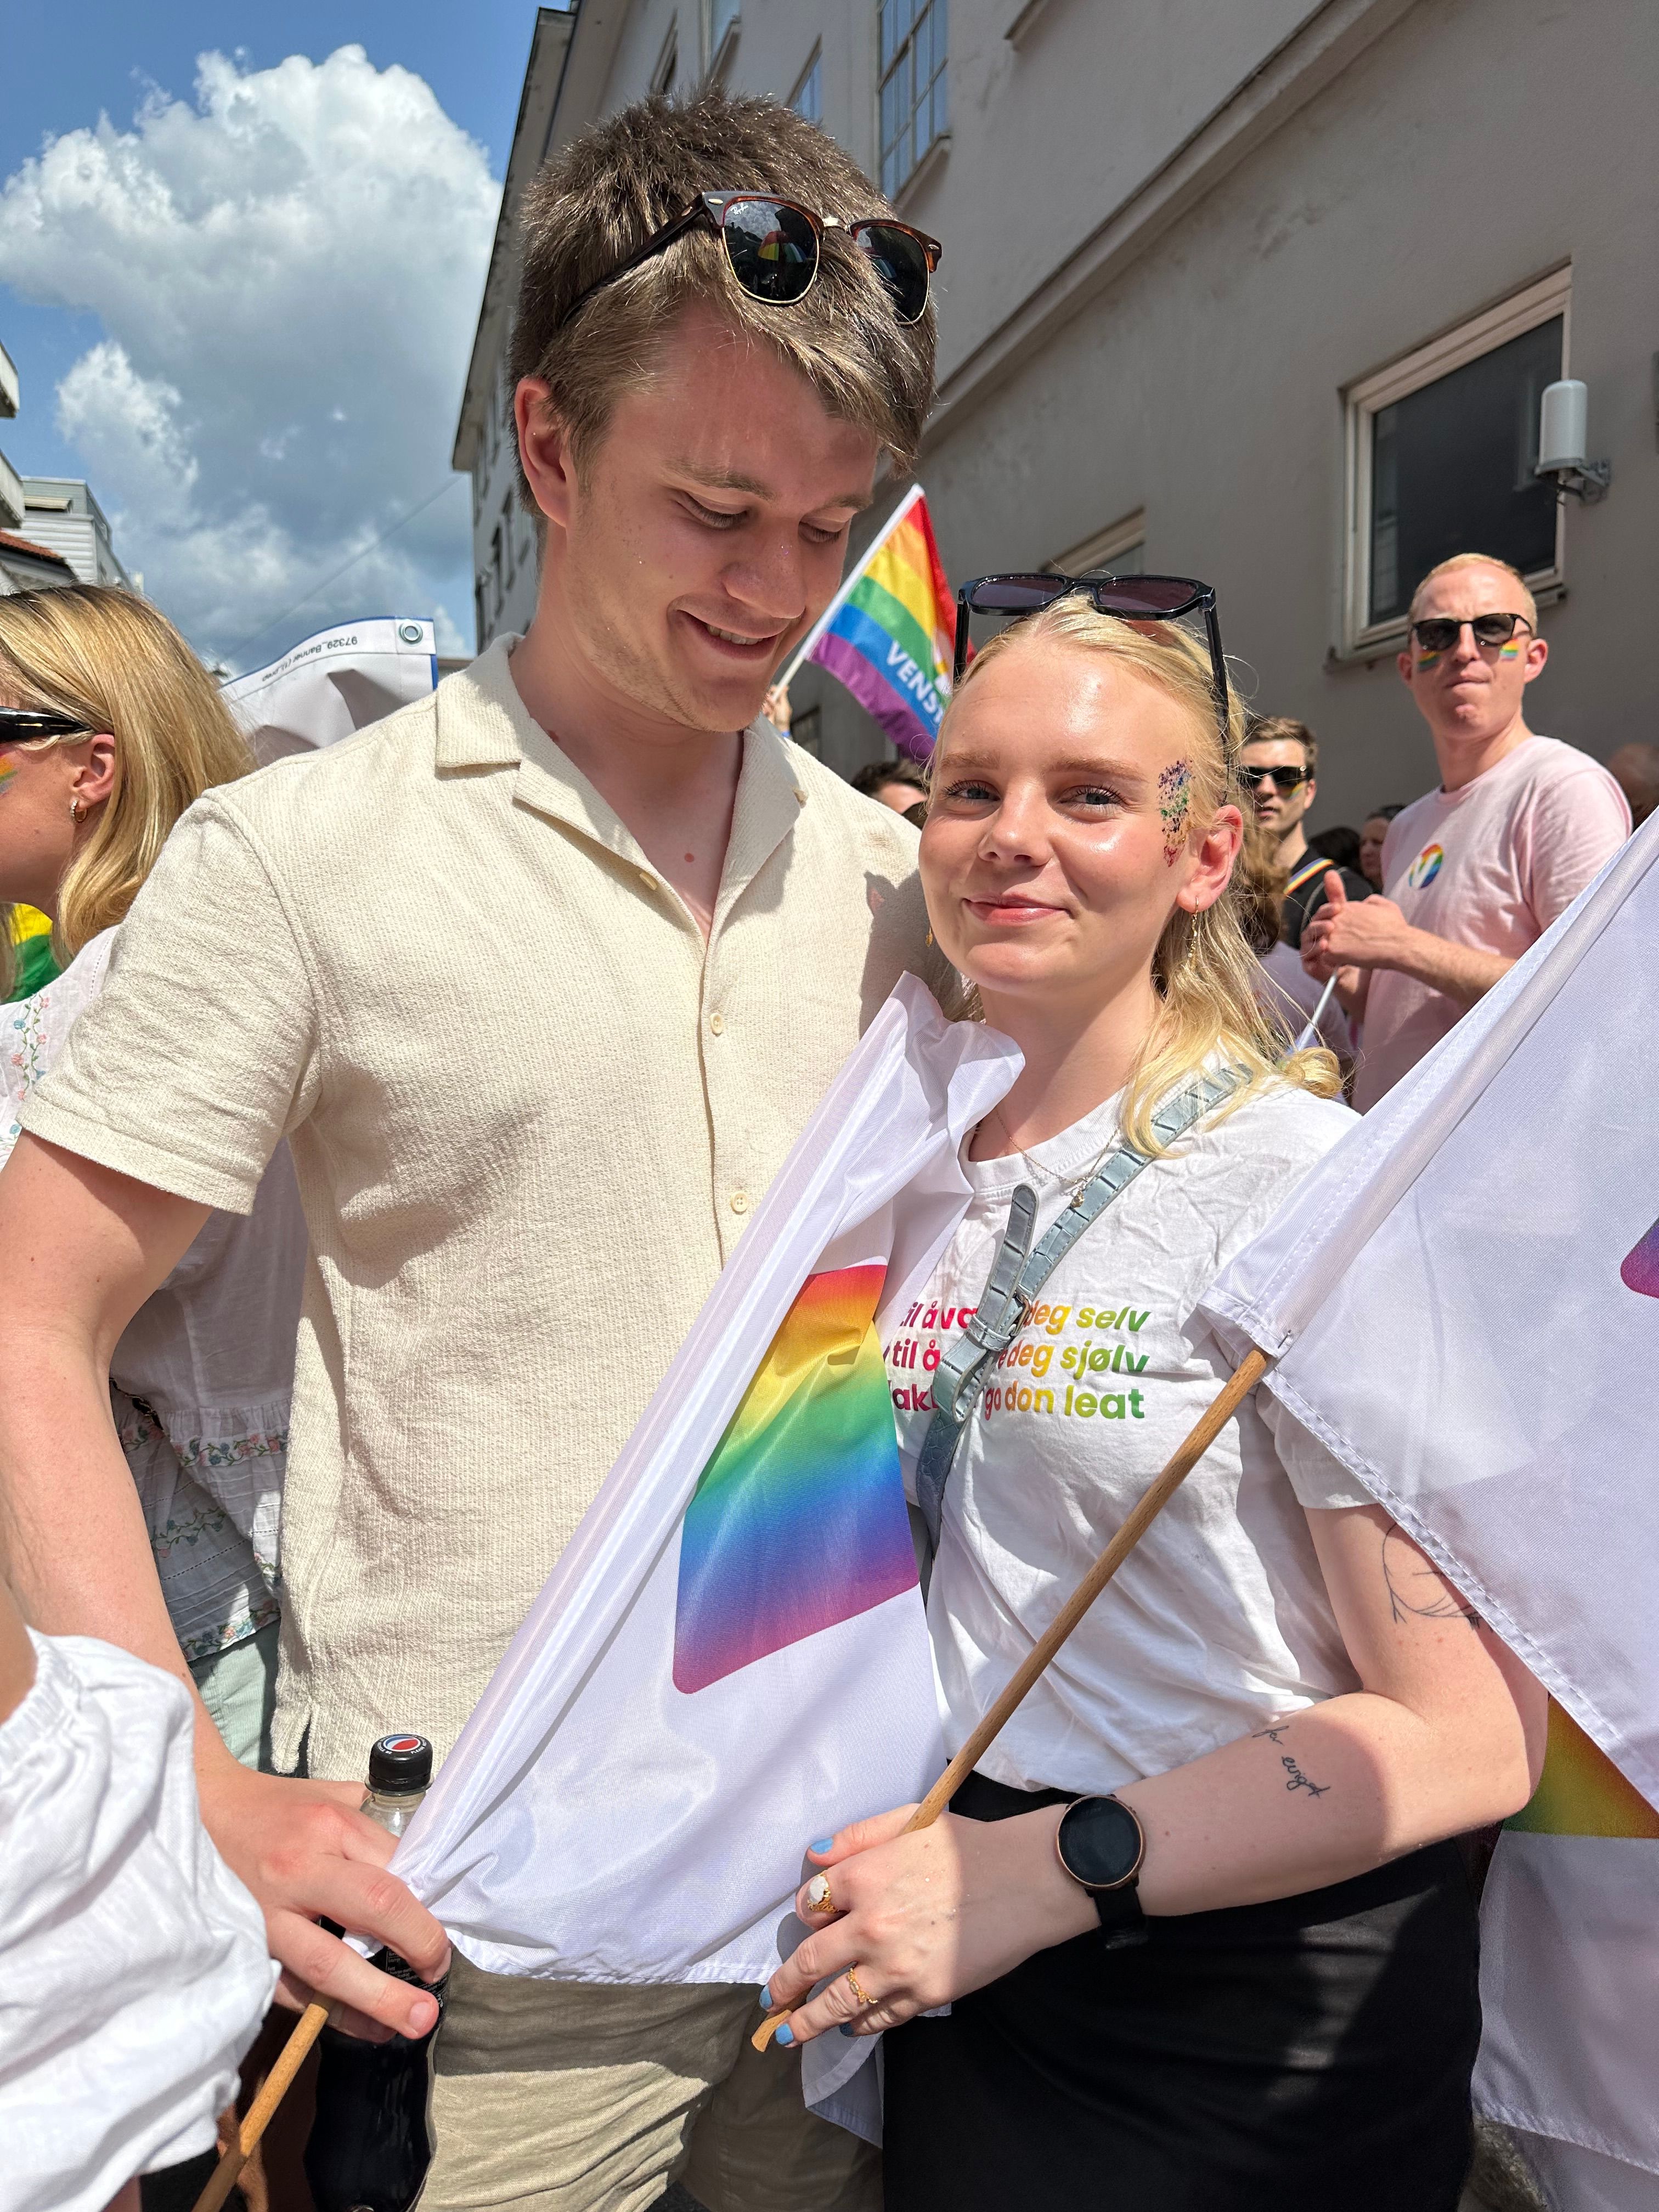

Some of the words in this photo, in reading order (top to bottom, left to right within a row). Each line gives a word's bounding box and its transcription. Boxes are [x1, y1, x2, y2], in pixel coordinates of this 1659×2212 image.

[900, 1301, 924, 1328] il
[922, 1300, 939, 1329] å
[1076, 1306, 1152, 1333] selv
[893, 1338, 918, 1369] til
[923, 1339, 940, 1372] å
[1007, 1339, 1055, 1378] deg
[1060, 1340, 1150, 1380] sjølv
[985, 1387, 1001, 1420] go
[1005, 1380, 1054, 1414] don
[1064, 1384, 1145, 1420] leat
